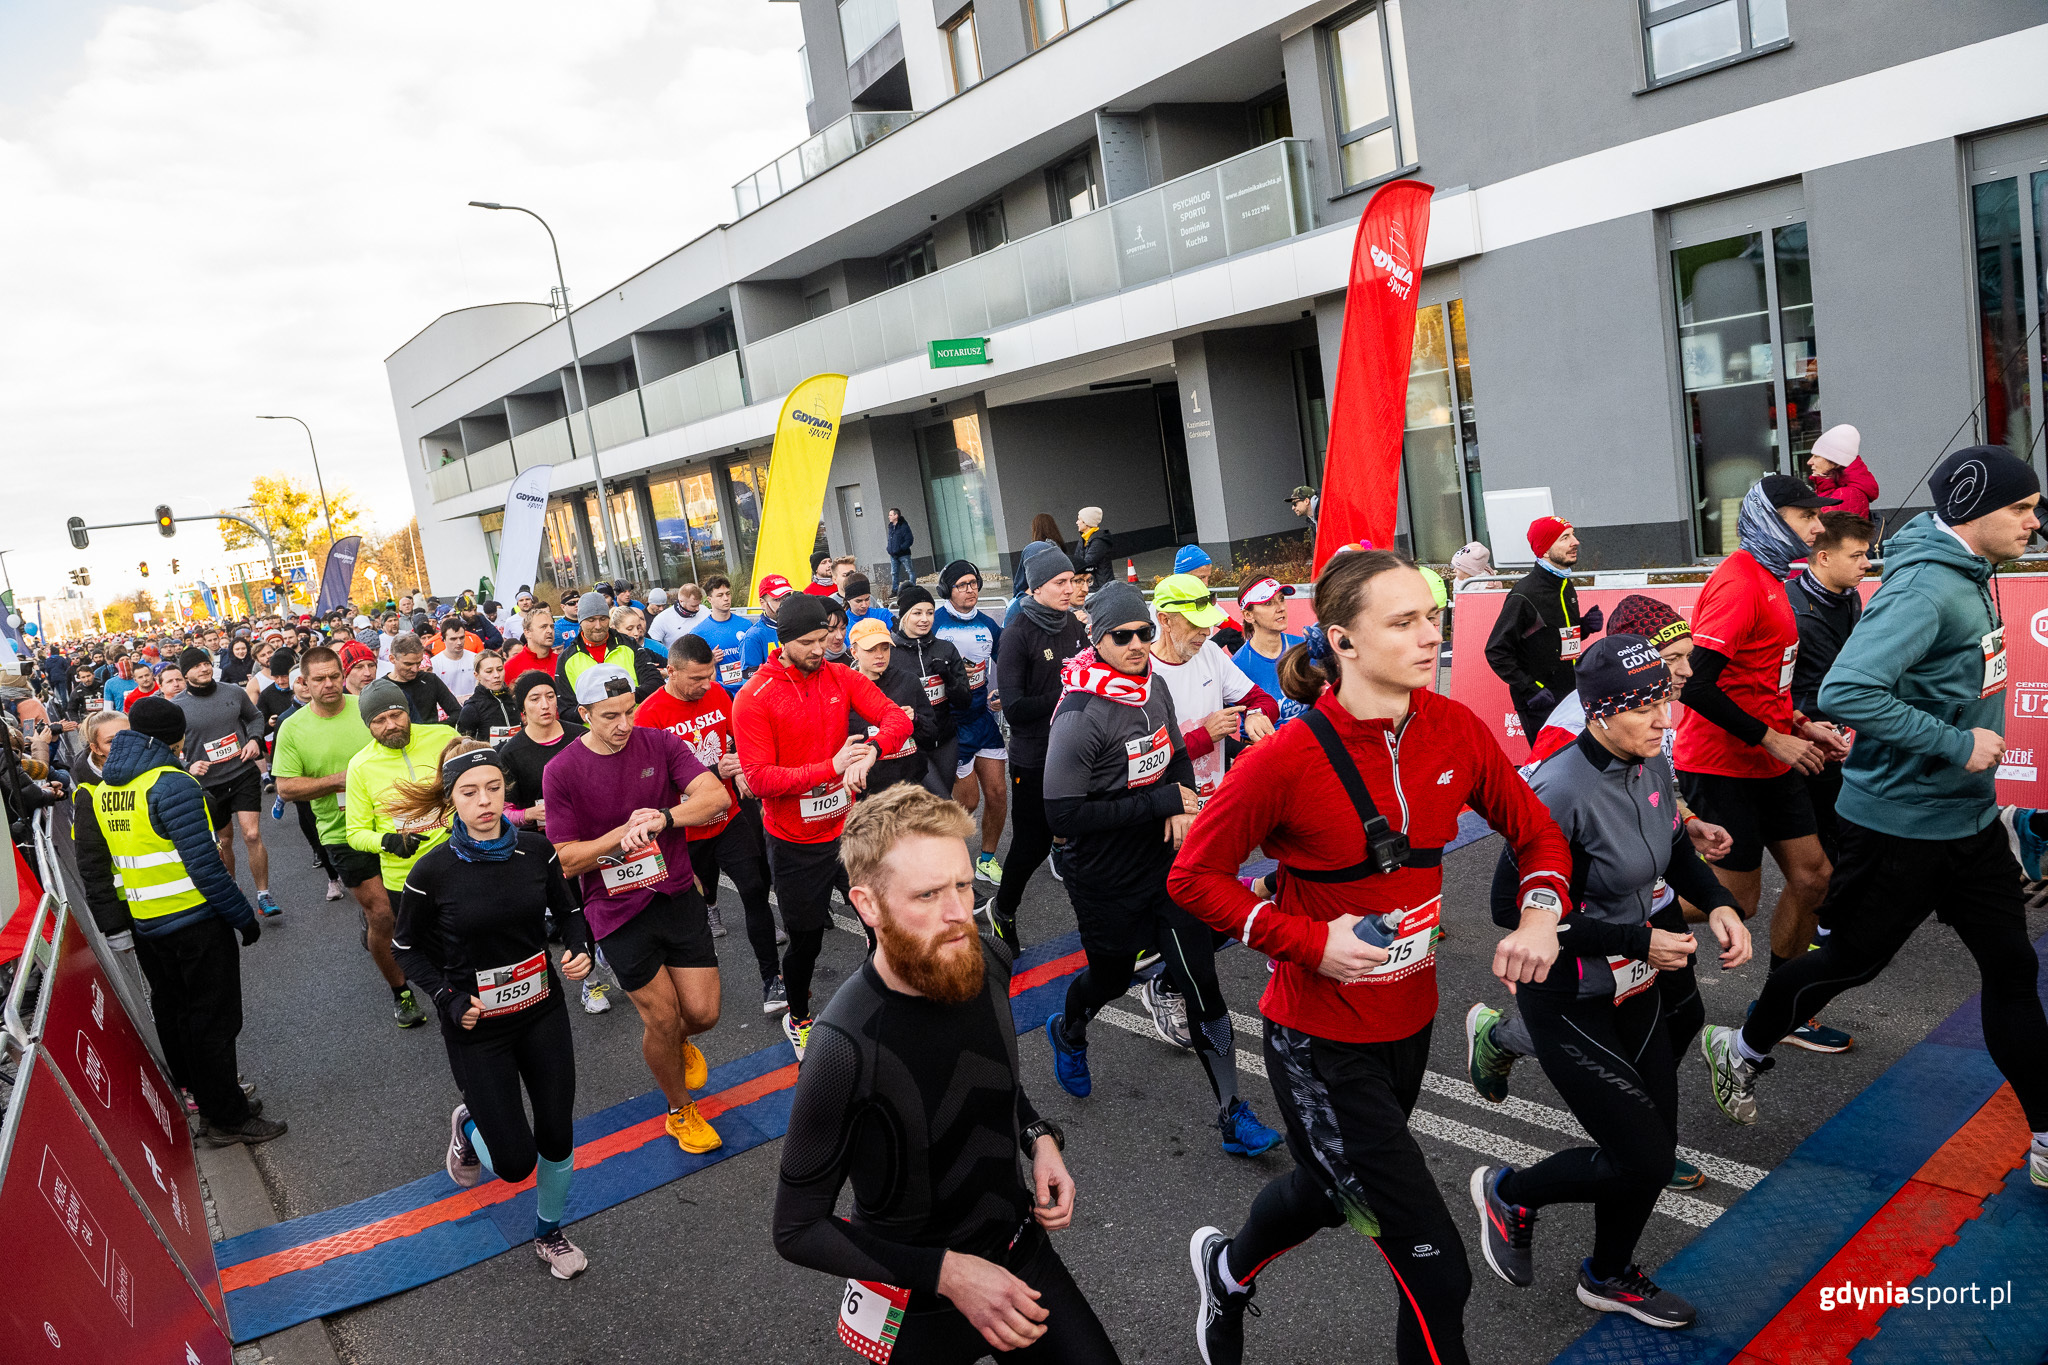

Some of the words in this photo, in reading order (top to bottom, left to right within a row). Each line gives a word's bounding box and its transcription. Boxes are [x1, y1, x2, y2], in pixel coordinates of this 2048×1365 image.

[1172, 190, 1211, 212] PSYCHOLOG
[1179, 207, 1207, 223] SPORTU
[1180, 221, 1210, 237] Dominika
[1185, 235, 1208, 249] Kuchta
[936, 347, 982, 358] NOTARIUSZ
[1190, 390, 1201, 413] 1
[792, 409, 833, 431] GDYNIA
[808, 427, 832, 440] sport
[516, 492, 545, 504] GDYNIA
[265, 588, 276, 602] P
[1663, 622, 1690, 639] STRA
[1568, 641, 1579, 651] 730
[665, 709, 727, 737] POLSKA
[216, 746, 232, 758] 1919
[1138, 751, 1166, 774] 2820
[101, 790, 136, 816] SĘDZIA
[812, 795, 839, 812] 1109
[617, 863, 644, 881] 962
[495, 981, 531, 1004] 1559
